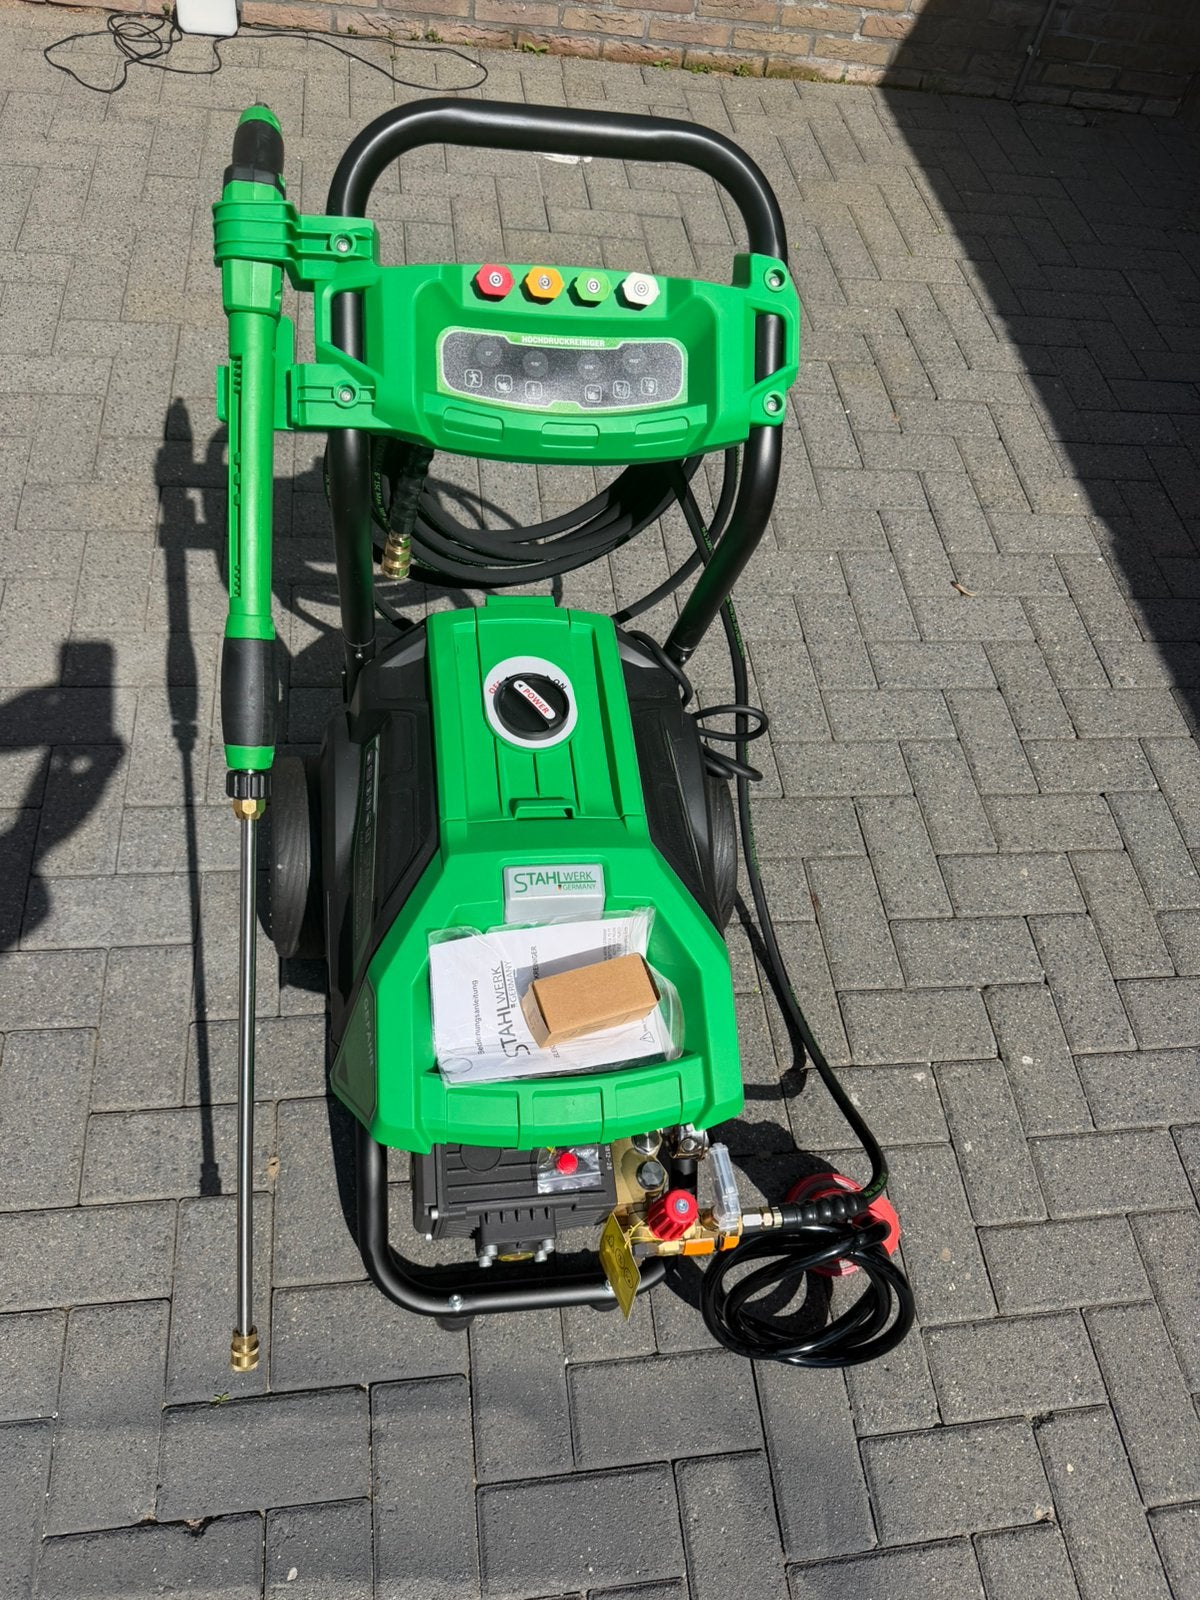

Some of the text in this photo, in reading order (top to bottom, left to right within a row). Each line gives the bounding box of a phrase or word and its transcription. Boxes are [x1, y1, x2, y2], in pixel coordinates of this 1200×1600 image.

[521, 335, 605, 347] HOCHDRUCKREINIGER
[554, 678, 567, 691] ON
[523, 688, 549, 714] POWER
[504, 960, 517, 1003] GERMANY
[472, 979, 485, 1055] Bedienungsanleitung
